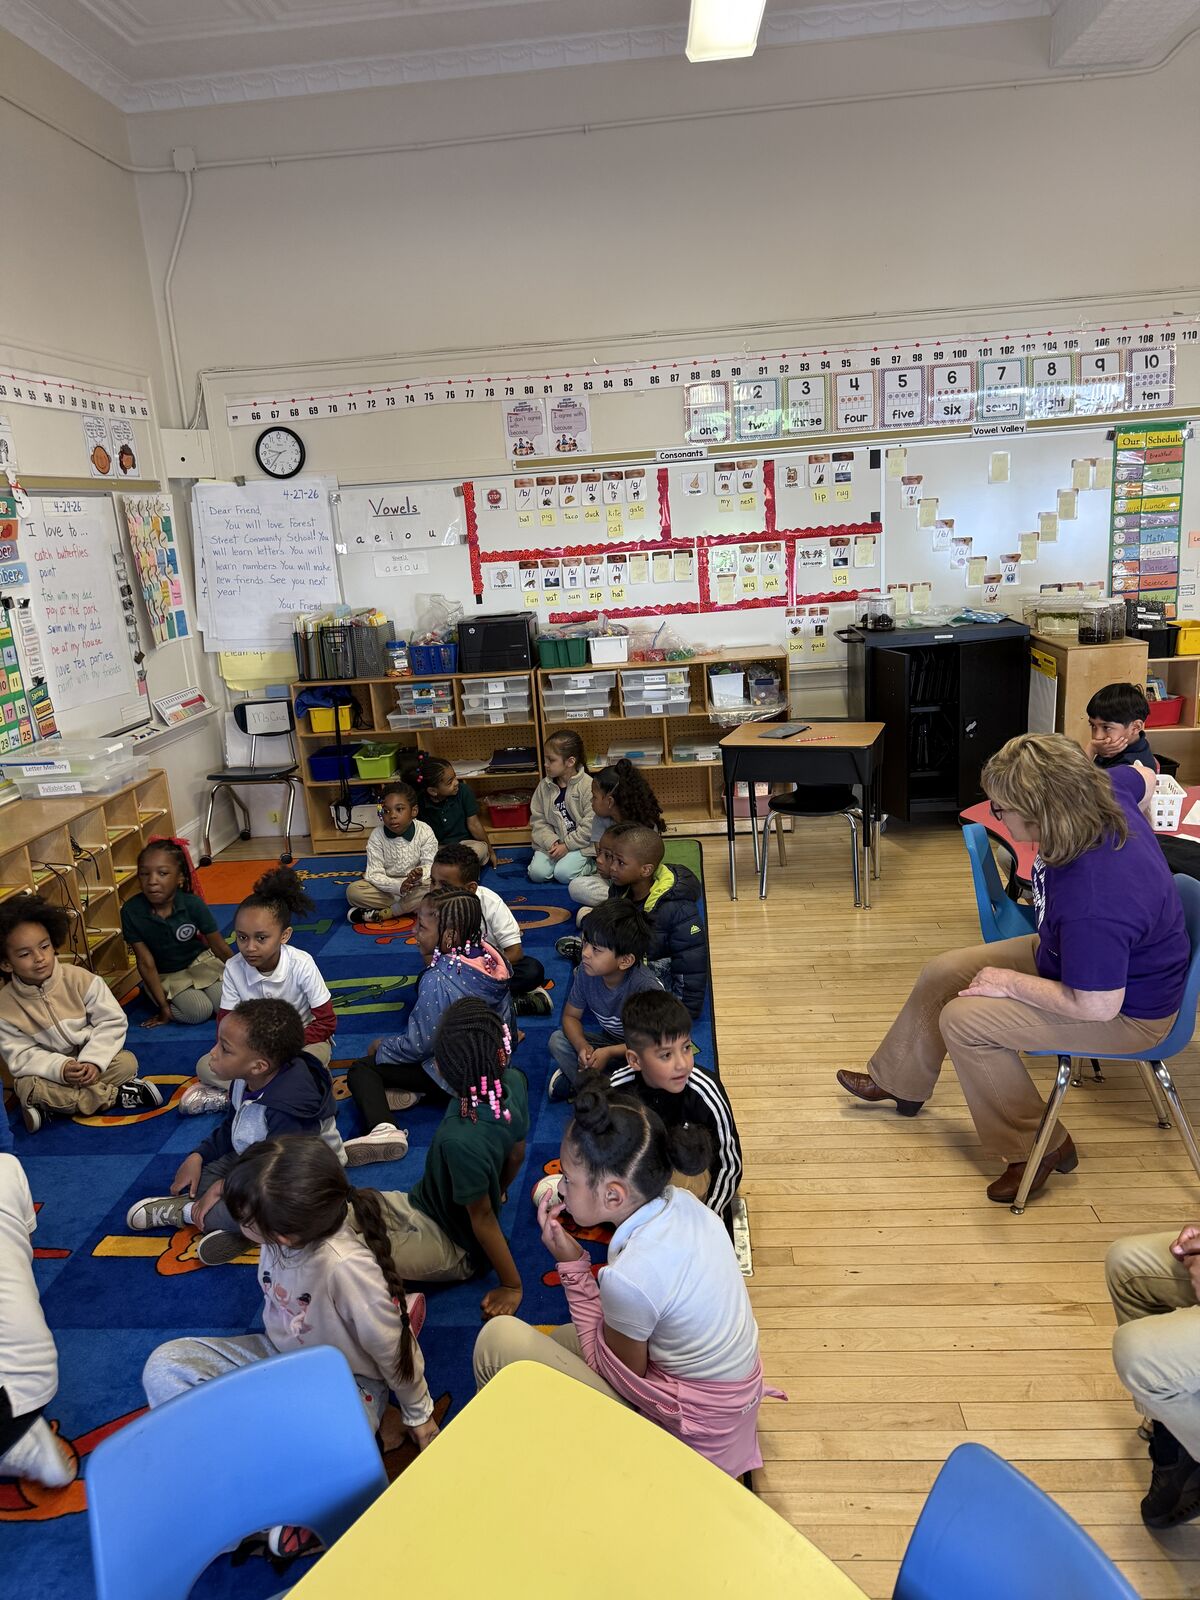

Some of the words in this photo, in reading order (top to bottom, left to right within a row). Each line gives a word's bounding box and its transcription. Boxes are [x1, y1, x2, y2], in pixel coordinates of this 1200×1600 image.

[1095, 358, 1105, 371] 9
[1144, 355, 1159, 368] 10
[997, 366, 1006, 380] 7
[1047, 362, 1057, 375] 8
[251, 412, 261, 420] 66
[290, 409, 299, 417] 68
[309, 407, 318, 415] 69
[328, 405, 338, 413] 70
[347, 403, 357, 411] 71
[367, 400, 376, 408] 72
[386, 398, 395, 406] 73
[405, 395, 415, 403] 74
[424, 392, 434, 400] 75
[445, 391, 455, 399] 76
[465, 390, 474, 398] 77
[485, 389, 494, 397] 78
[524, 386, 534, 394] 80
[563, 384, 573, 392] 82
[584, 382, 593, 390] 83
[603, 380, 613, 388] 84
[624, 378, 633, 386] 85
[650, 376, 660, 384] 86
[670, 374, 679, 382] 87
[690, 372, 700, 380] 88
[711, 370, 721, 378] 89
[731, 368, 741, 376] 90
[758, 367, 768, 375] 91
[779, 365, 789, 373] 92
[800, 363, 810, 371] 93
[821, 361, 831, 369] 94
[841, 359, 851, 367] 95
[891, 356, 901, 364] 97
[933, 352, 943, 360] 99
[952, 350, 967, 358] 100
[978, 348, 993, 357] 101
[1000, 346, 1015, 354] 102
[1021, 344, 1036, 352] 103
[1043, 342, 1057, 350] 104
[1064, 340, 1079, 348] 105
[1138, 335, 1154, 343] 108
[1160, 333, 1176, 341] 109
[1182, 331, 1197, 339] 110
[947, 371, 957, 384] 6
[850, 378, 860, 391] 4
[898, 374, 908, 388] 5
[753, 385, 763, 399] 2
[801, 381, 810, 395] 3
[1142, 391, 1160, 400] ten
[892, 410, 914, 419] five
[943, 404, 961, 415] six
[844, 413, 868, 423] four
[699, 425, 719, 435] one
[974, 427, 998, 435] Vowel
[1001, 425, 1024, 434] Valley
[1122, 438, 1139, 446] Our
[1148, 434, 1183, 443] Schedule
[660, 450, 703, 460] Consonants
[283, 489, 319, 499] 4-27-26
[814, 493, 826, 501] lip
[836, 490, 848, 499] rug
[369, 496, 418, 515] Vowels
[721, 498, 730, 507] my
[740, 497, 753, 505] nest
[1143, 502, 1166, 510] Lunch
[54, 501, 81, 513] 4-29-26
[210, 507, 231, 515] Dear
[629, 506, 644, 515] gate
[225, 519, 240, 529] You
[246, 520, 261, 529] will
[267, 520, 284, 528] love
[290, 518, 316, 528] Forest
[609, 524, 621, 532] cat
[26, 522, 36, 537] I
[44, 522, 63, 537] love
[210, 535, 239, 544] Street
[244, 533, 282, 547] Community
[318, 532, 329, 542] You
[356, 536, 364, 544] a
[375, 534, 381, 542] e
[390, 531, 393, 540] i
[1146, 533, 1165, 542] Math
[34, 549, 53, 561] catch
[56, 544, 88, 559] butterflies
[212, 548, 227, 556] will
[232, 547, 252, 556] learn
[289, 546, 304, 555] You
[308, 546, 322, 555] will
[216, 561, 236, 570] learn
[280, 560, 294, 570] You
[298, 561, 310, 570] will
[1144, 564, 1168, 572] Dance
[217, 576, 230, 584] new
[270, 576, 286, 584] See
[292, 578, 305, 590] you
[309, 576, 327, 586] next
[765, 579, 779, 588] yak
[833, 574, 847, 584] jog
[743, 582, 755, 591] wig
[217, 586, 241, 598] year!
[589, 591, 602, 599] zip
[612, 589, 623, 597] hat
[278, 599, 295, 609] Your
[47, 625, 62, 634] swim
[64, 622, 75, 632] with
[90, 618, 101, 631] dad
[82, 639, 102, 648] house
[790, 642, 802, 650] box
[12, 678, 19, 688] 11
[6, 708, 13, 719] 17
[18, 704, 26, 714] 18
[22, 731, 31, 741] 25
